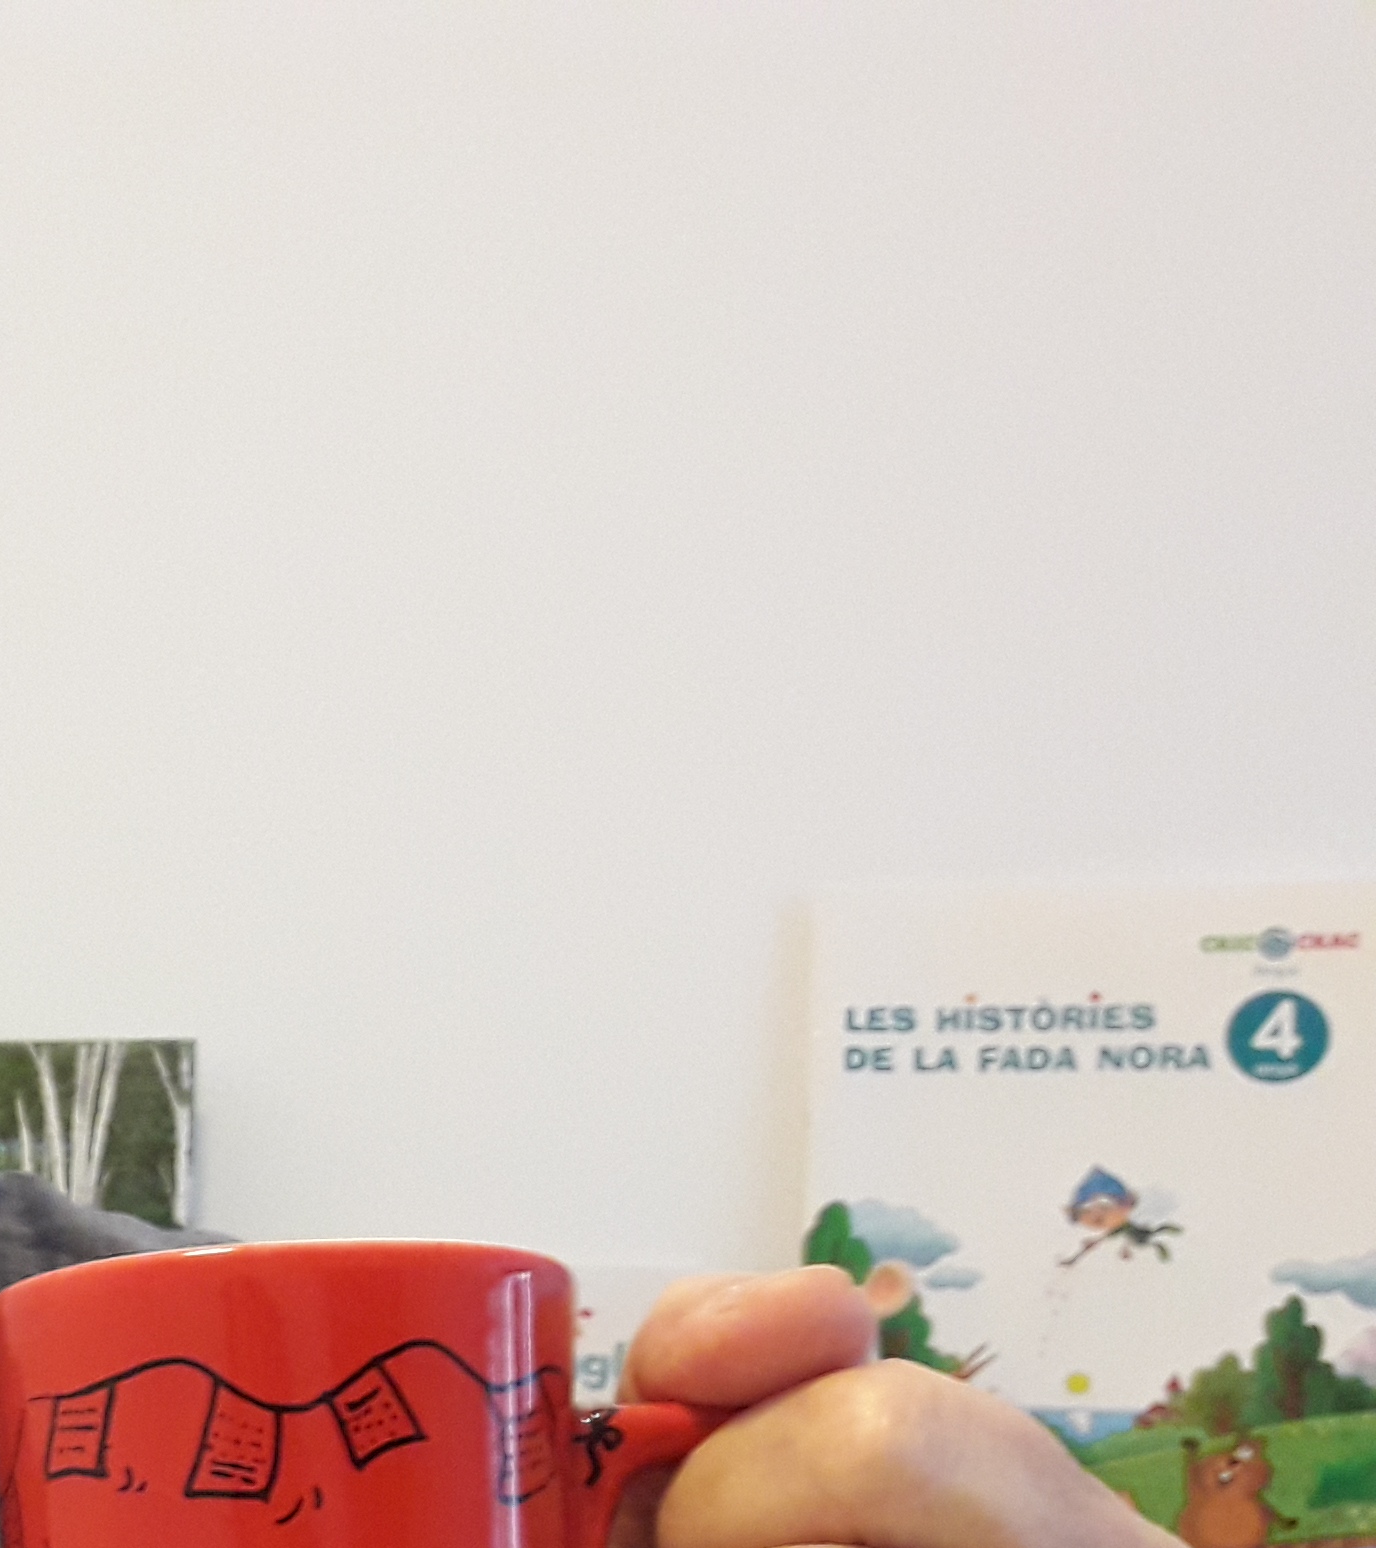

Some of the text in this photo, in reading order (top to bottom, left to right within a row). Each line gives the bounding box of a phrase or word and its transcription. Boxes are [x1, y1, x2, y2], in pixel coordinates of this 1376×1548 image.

[845, 1004, 916, 1032] LES
[1249, 998, 1305, 1061] 4
[845, 1044, 1211, 1072] DE LA FADA NORA
